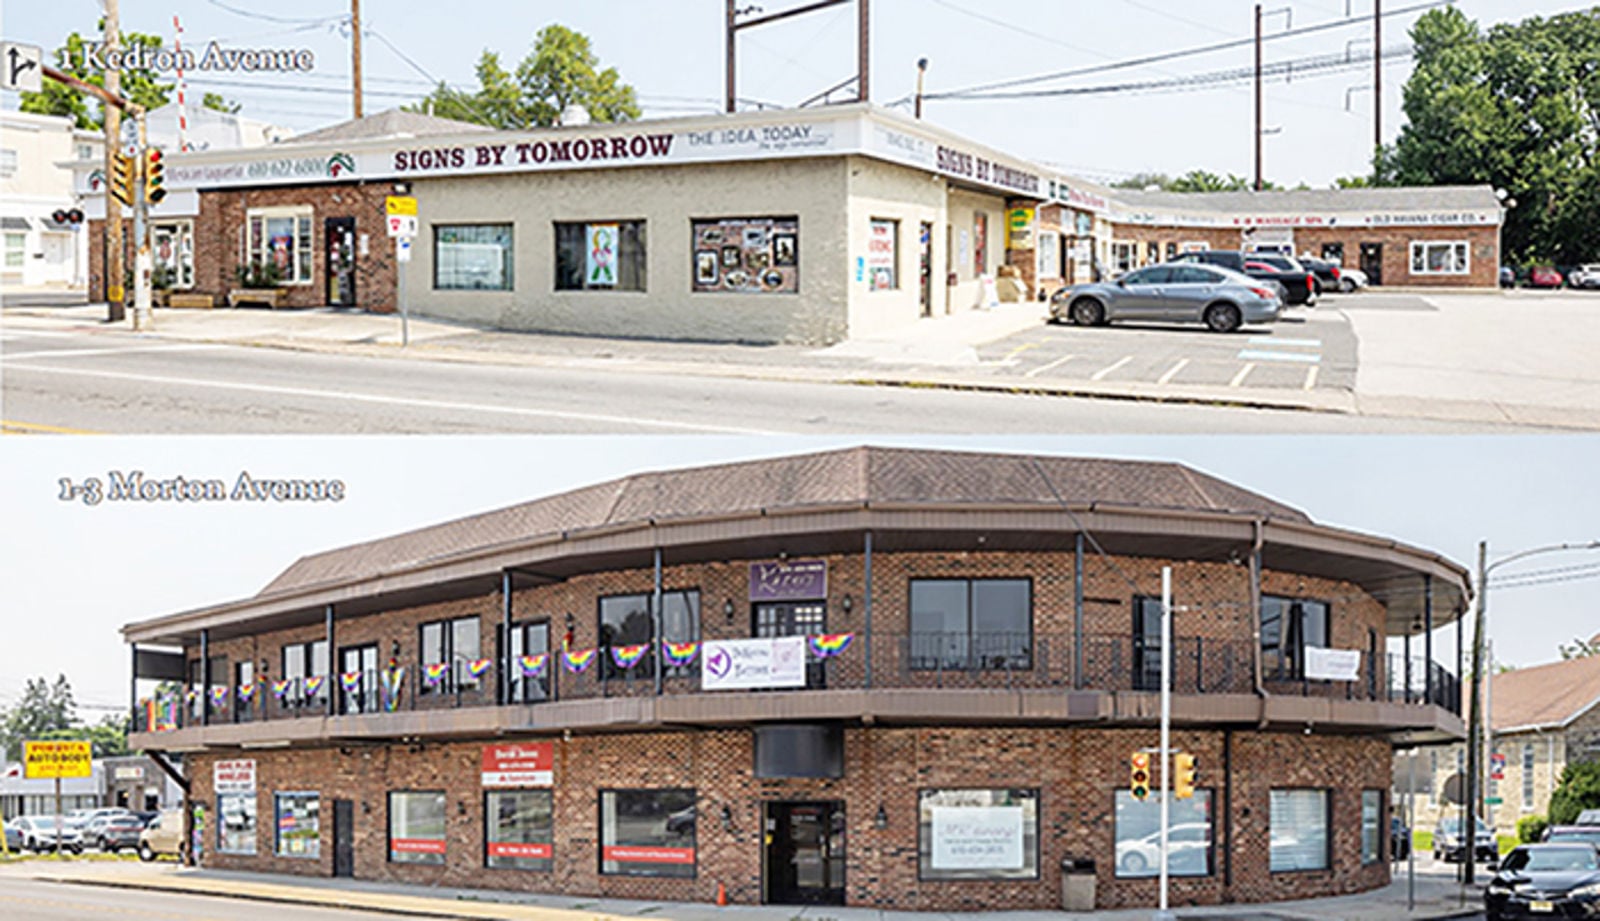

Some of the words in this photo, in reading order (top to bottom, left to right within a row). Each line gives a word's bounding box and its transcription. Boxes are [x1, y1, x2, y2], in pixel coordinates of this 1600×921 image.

[688, 132, 713, 146] THE
[721, 129, 756, 144] IDEA
[763, 126, 811, 141] TODAY
[394, 148, 465, 171] SIGNS
[475, 145, 507, 167] BY
[515, 134, 674, 164] TOMORROW
[937, 145, 972, 177] SIGNS
[1373, 214, 1391, 223] OLD
